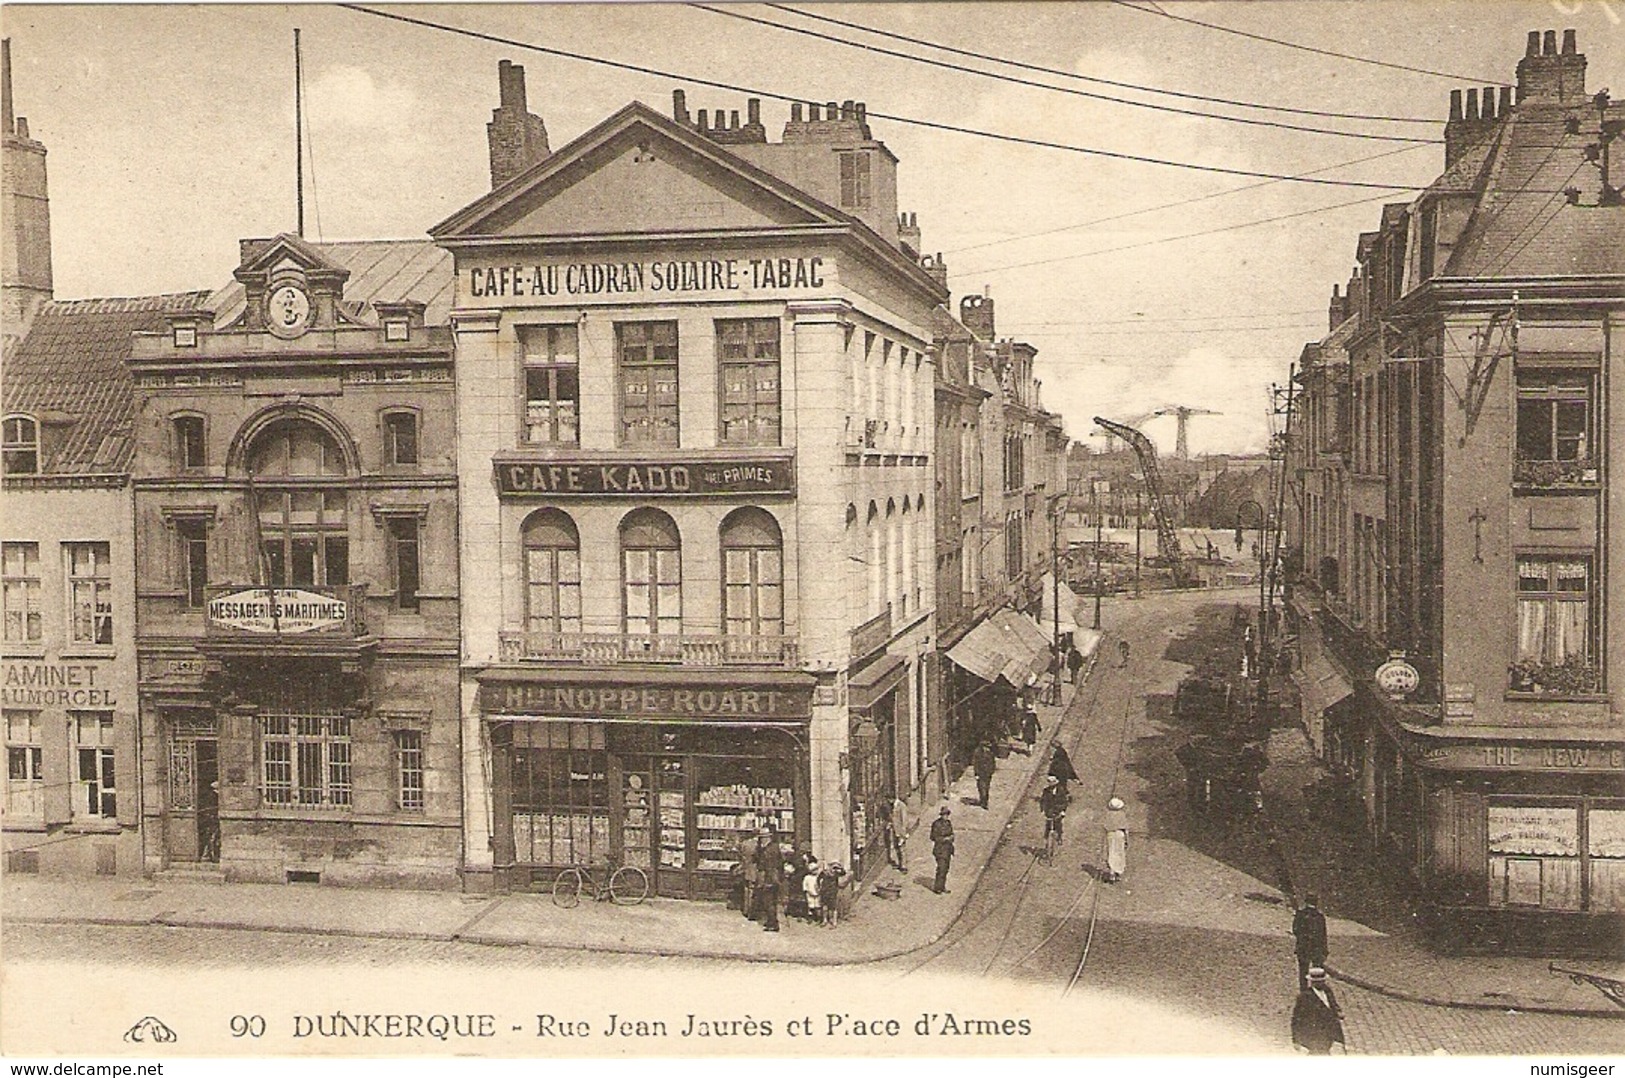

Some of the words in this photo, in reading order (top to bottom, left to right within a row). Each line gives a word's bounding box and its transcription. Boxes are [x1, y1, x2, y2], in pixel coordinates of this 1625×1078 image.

[531, 265, 560, 296] AU
[566, 262, 645, 294] CADRAN
[650, 259, 740, 291] SOLAIRE
[749, 256, 824, 289] TABAC
[601, 465, 691, 491] KADO
[723, 466, 774, 484] PRIMES
[209, 602, 283, 619] MESSAGERIES
[284, 601, 346, 620] MARITIMES
[1, 664, 99, 686] AMINET
[1484, 747, 1523, 766] THE
[1542, 748, 1590, 767] NEW
